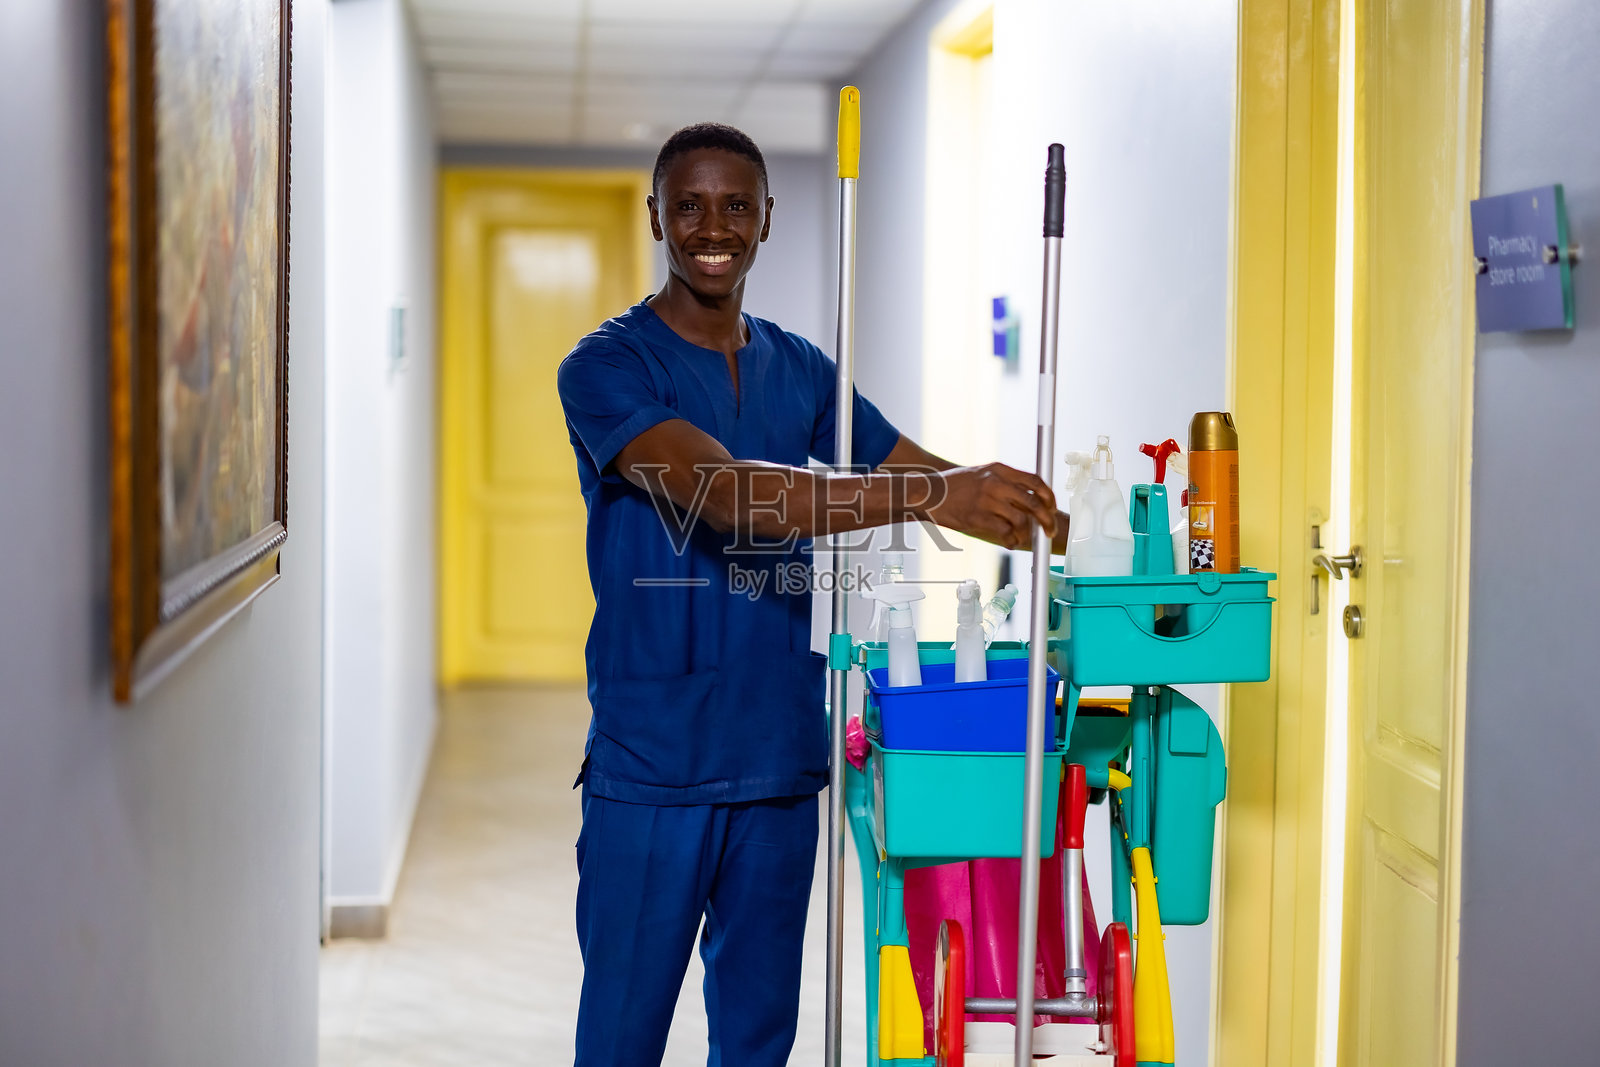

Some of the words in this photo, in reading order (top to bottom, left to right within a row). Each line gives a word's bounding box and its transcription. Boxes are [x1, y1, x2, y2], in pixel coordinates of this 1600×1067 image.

[1488, 235, 1537, 258] Pharmacy
[1489, 267, 1514, 286] store
[1516, 265, 1545, 282] room
